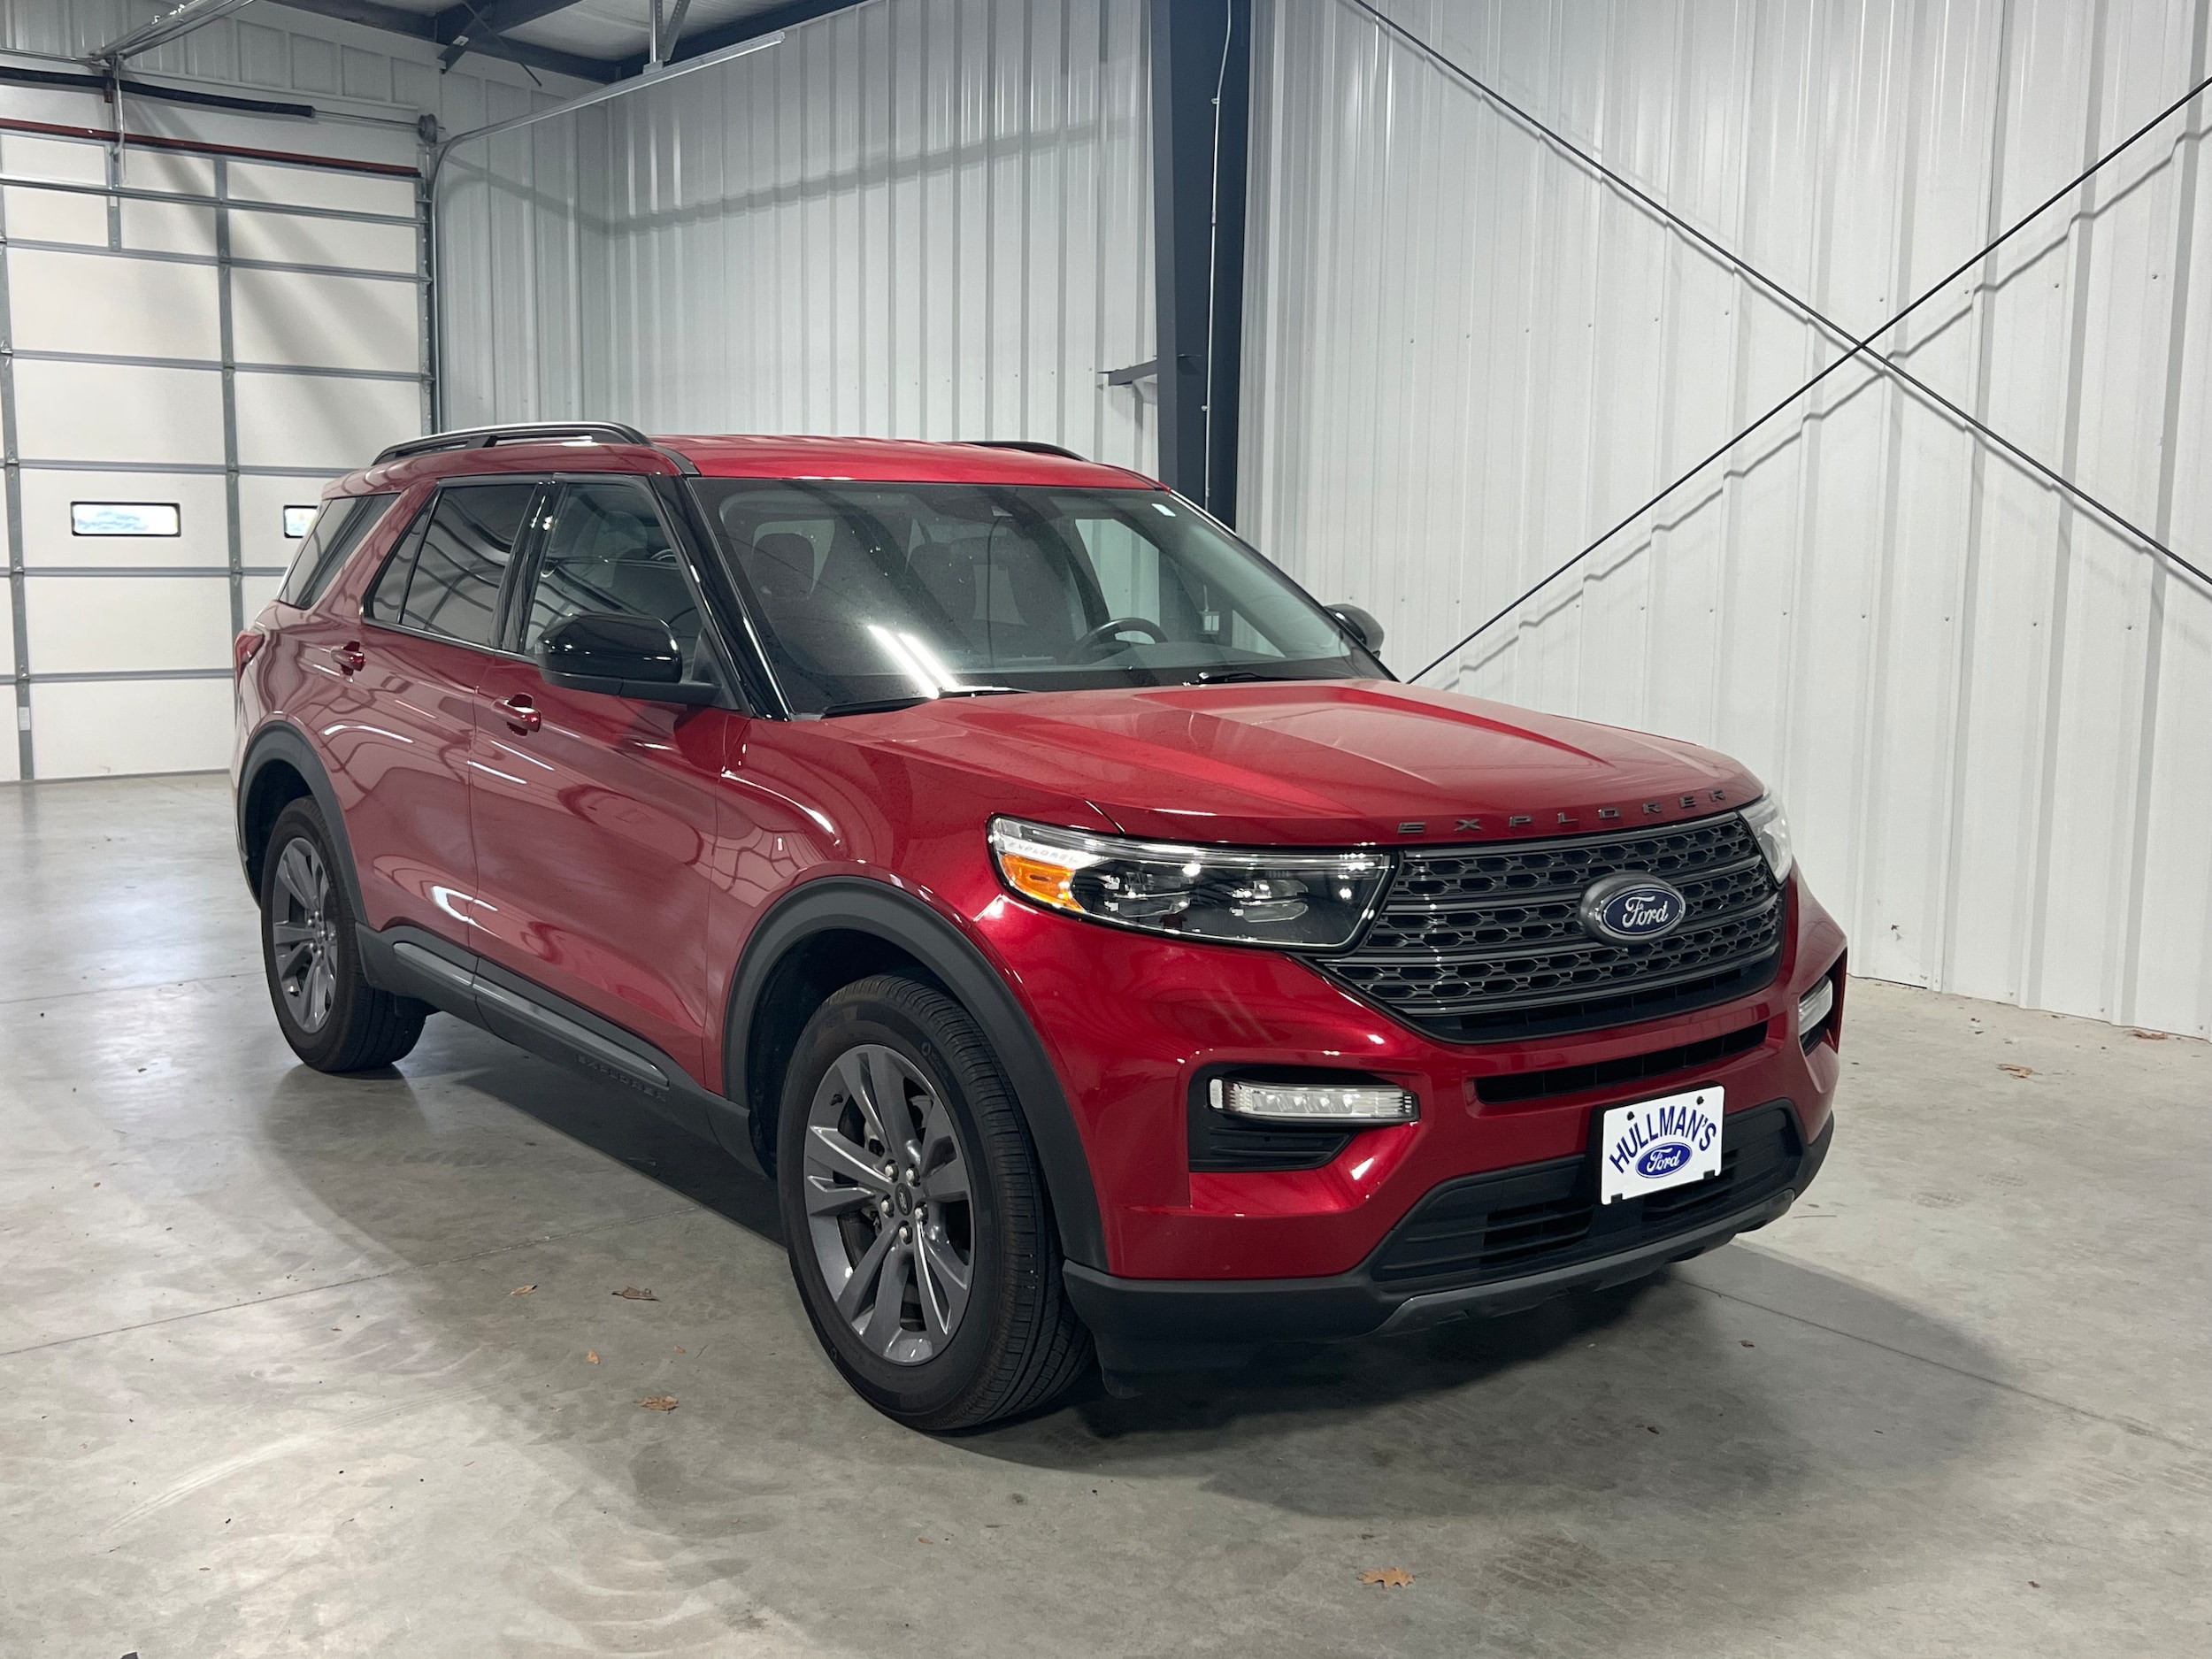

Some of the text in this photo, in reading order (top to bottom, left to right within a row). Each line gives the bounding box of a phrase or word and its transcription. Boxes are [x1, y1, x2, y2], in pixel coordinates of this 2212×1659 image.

[1397, 789, 1726, 835] EXPLORER
[1621, 895, 1670, 929] Ford
[1609, 1105, 1717, 1174] HULLMAN'S
[1646, 1147, 1680, 1173] Ford
